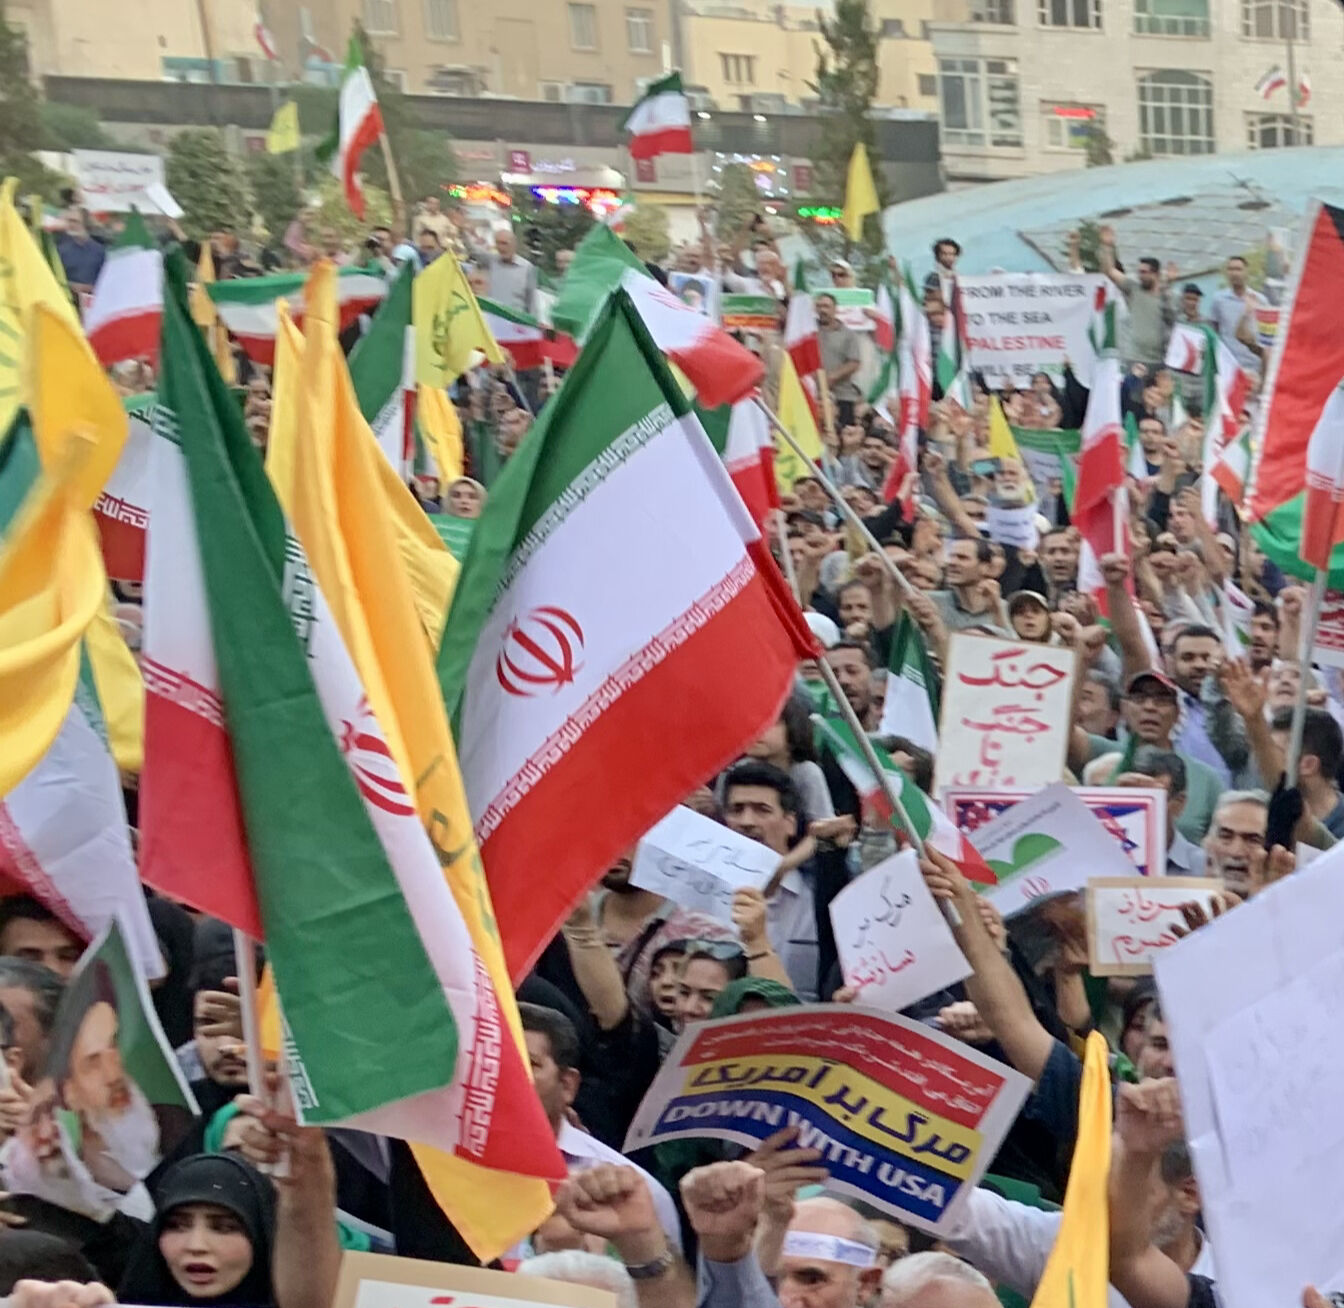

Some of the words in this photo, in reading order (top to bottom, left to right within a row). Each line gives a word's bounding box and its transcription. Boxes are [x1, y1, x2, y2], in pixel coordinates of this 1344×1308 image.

[1007, 284, 1039, 298] THE
[1039, 284, 1087, 297] RIVER
[987, 312, 1019, 325] THE
[1022, 311, 1054, 324] SEA
[966, 335, 1067, 351] PALESTINE
[957, 649, 1068, 701] جنگ
[689, 1057, 838, 1090] آمریکا
[822, 1084, 874, 1122] بر
[663, 1099, 782, 1126] DOWN
[784, 1109, 873, 1175] WITH
[875, 1159, 947, 1209] USA
[866, 1110, 973, 1166] مرگ
